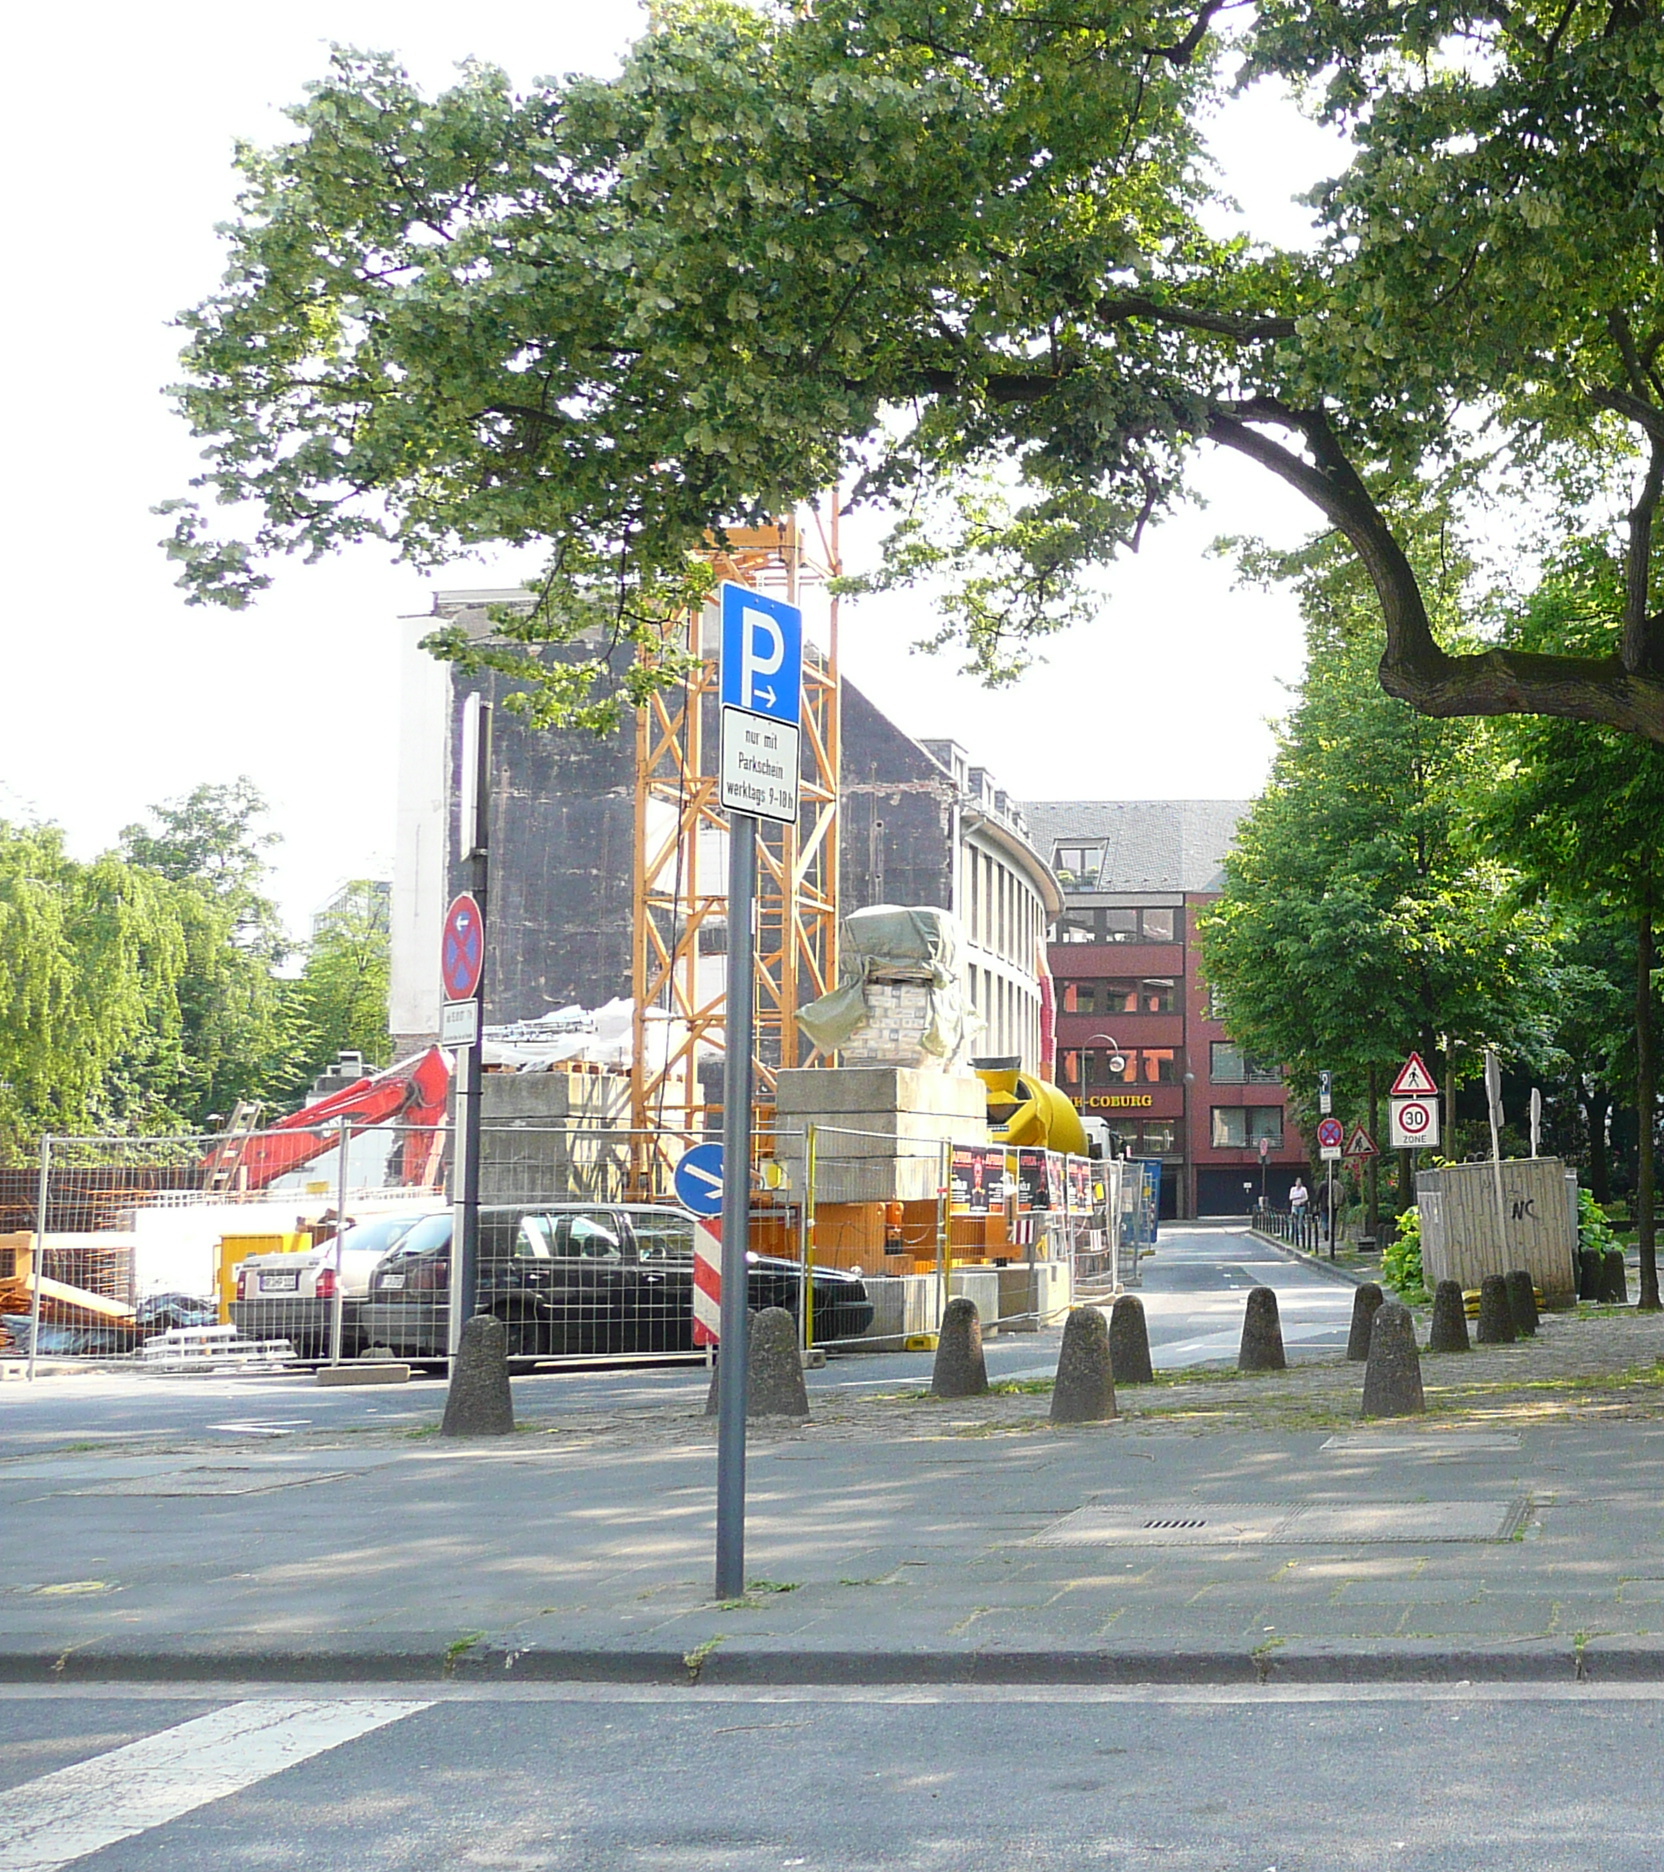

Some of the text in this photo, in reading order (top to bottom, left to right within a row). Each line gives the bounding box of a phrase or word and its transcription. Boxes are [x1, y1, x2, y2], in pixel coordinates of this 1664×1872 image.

[741, 606, 784, 709] P
[745, 730, 778, 750] nur mit
[738, 751, 784, 780] Parkschein
[726, 780, 766, 806] werktags
[1405, 1111, 1423, 1125] 30
[1403, 1134, 1427, 1144] ZONE
